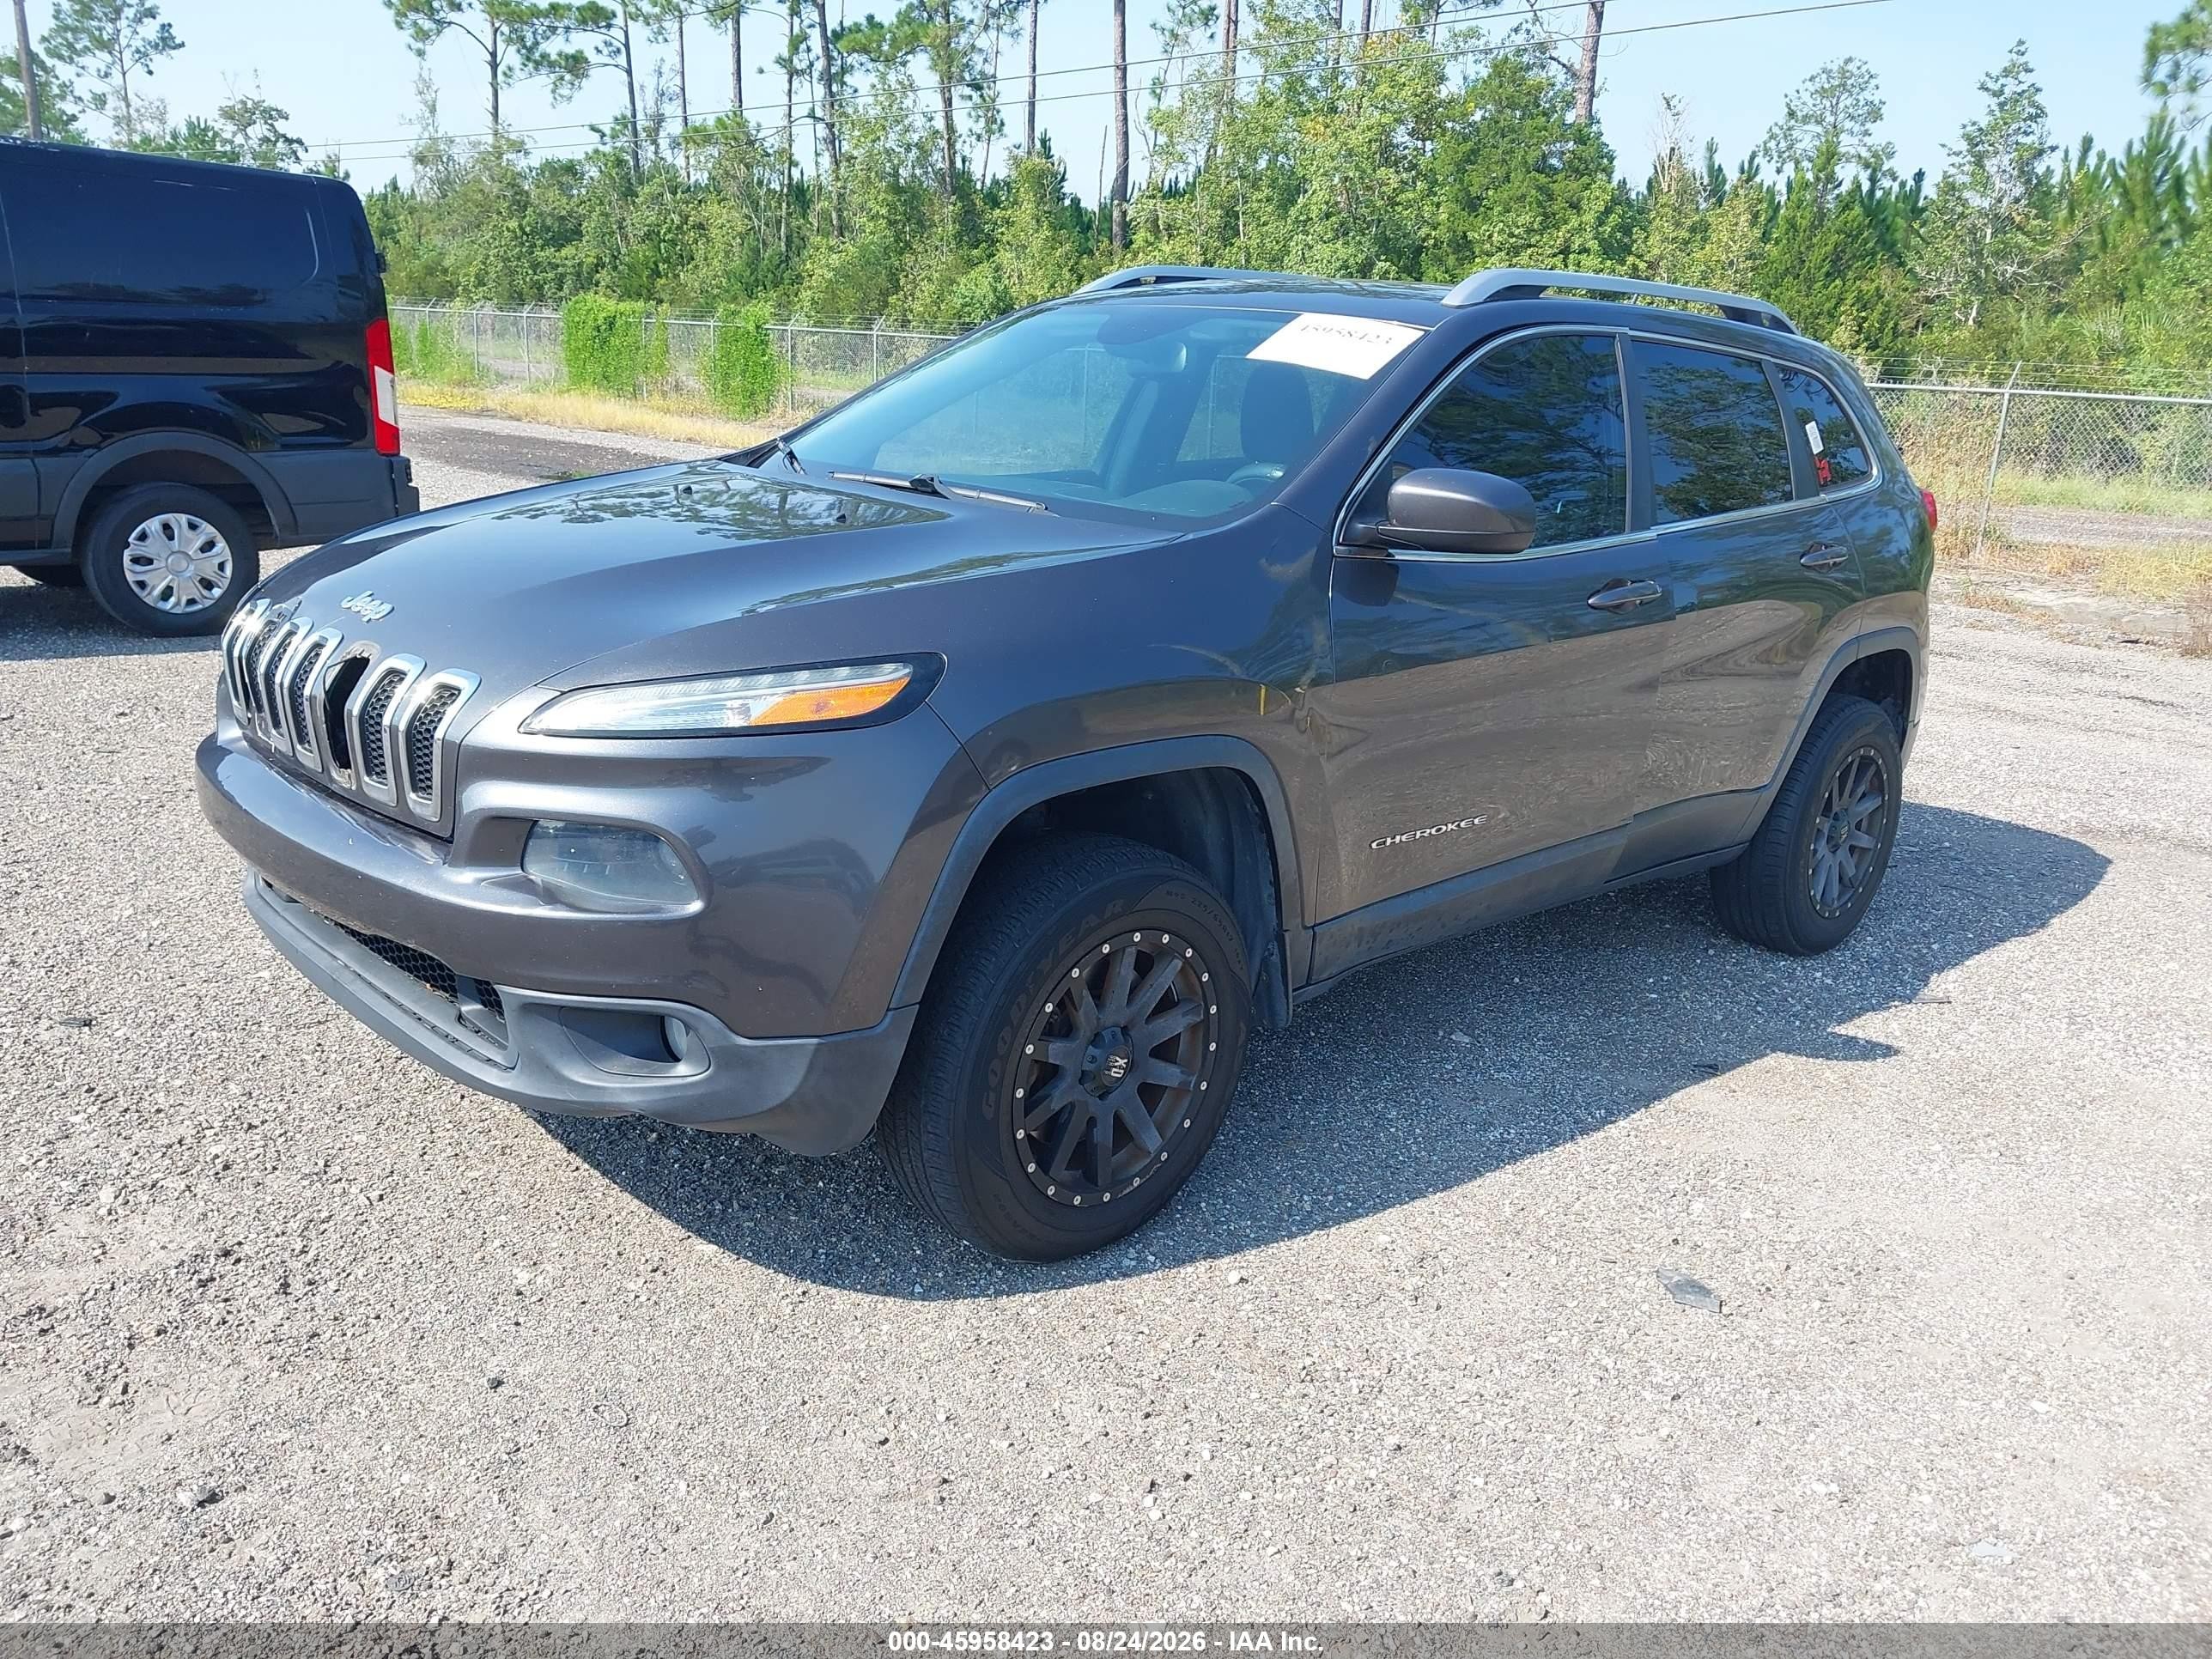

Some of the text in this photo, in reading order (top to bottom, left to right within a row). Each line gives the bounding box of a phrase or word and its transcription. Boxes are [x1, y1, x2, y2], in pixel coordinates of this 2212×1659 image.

[340, 590, 394, 623] Jeep
[1370, 814, 1488, 849] CHEROKEE
[1111, 1055, 1128, 1078] XD
